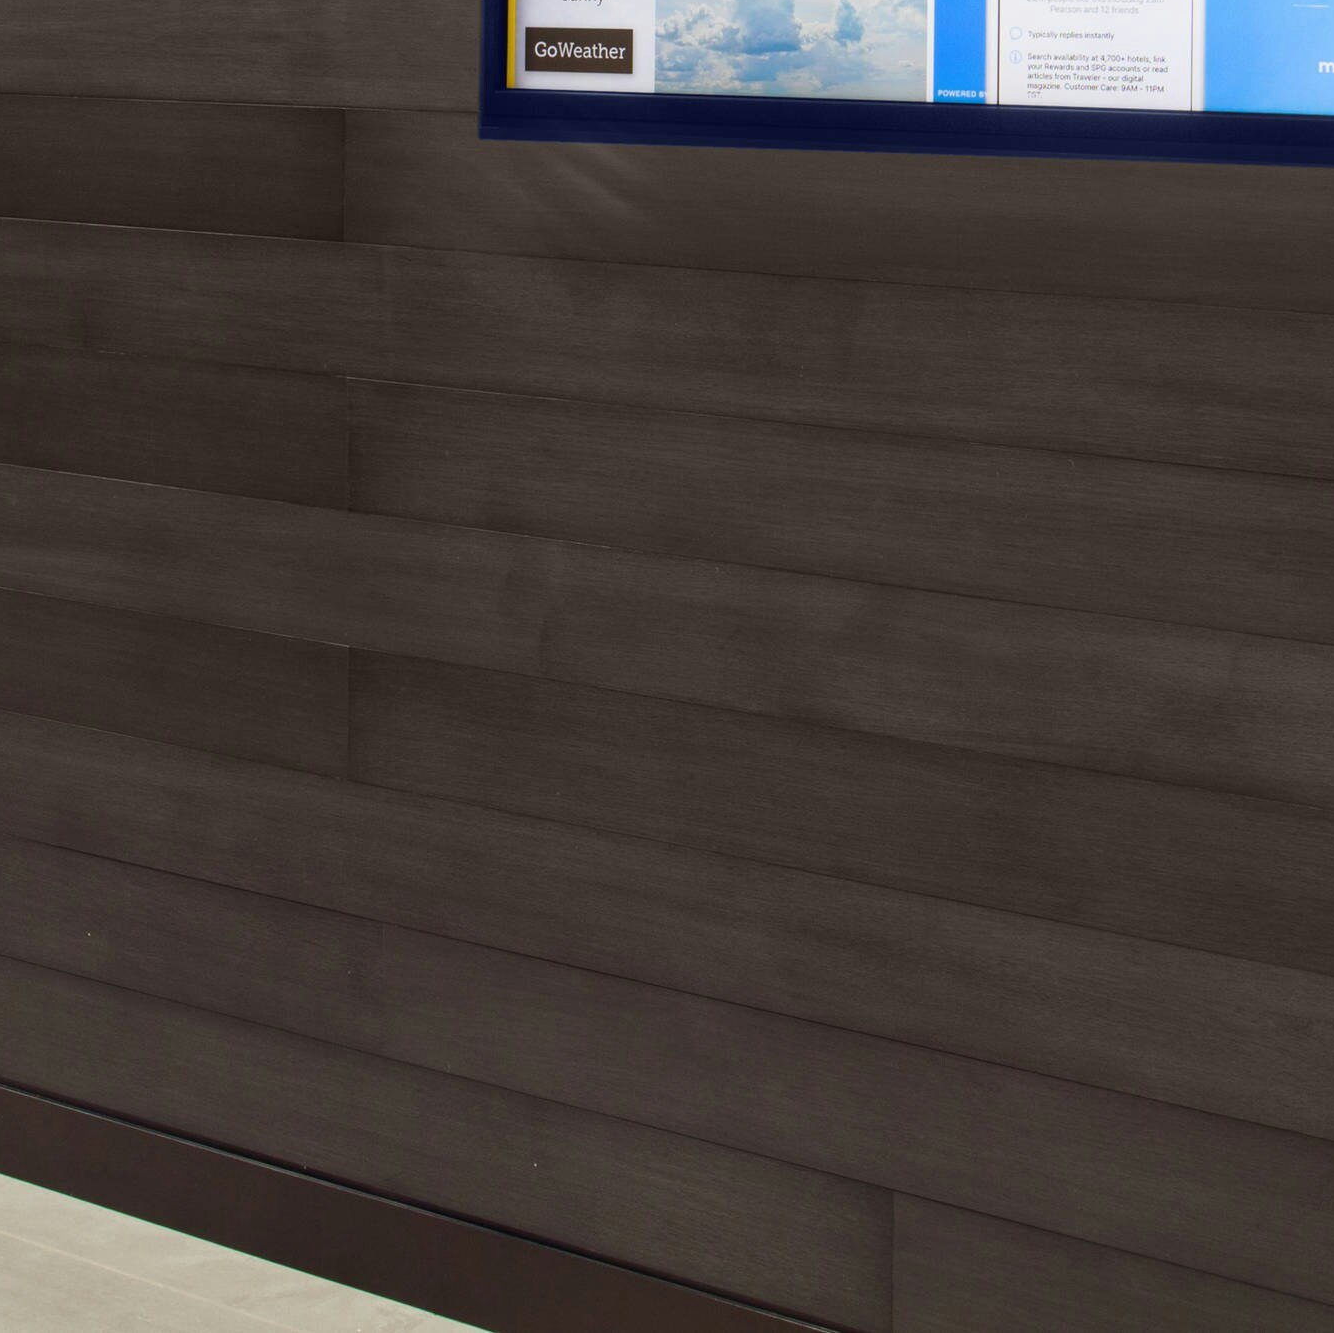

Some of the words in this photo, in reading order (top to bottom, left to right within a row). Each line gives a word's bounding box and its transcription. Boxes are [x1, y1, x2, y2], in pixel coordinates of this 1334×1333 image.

[1083, 6, 1099, 14] and
[1112, 6, 1139, 15] friends
[1028, 30, 1058, 39] Typically
[1059, 31, 1083, 40] replies
[1084, 31, 1115, 40] instantly
[534, 41, 626, 59] GoWeather
[1027, 53, 1052, 61] Search
[1053, 53, 1089, 63] availability
[1153, 55, 1166, 63] link
[1028, 64, 1044, 72] your
[1044, 62, 1075, 71] Rewards
[1076, 63, 1089, 71] and
[1108, 65, 1141, 73] accounts
[1151, 65, 1169, 73] read
[1027, 72, 1052, 80] articles
[1054, 73, 1071, 81] from
[1121, 74, 1144, 83] digital
[1064, 82, 1098, 91] Customer
[937, 89, 976, 98] POWERED
